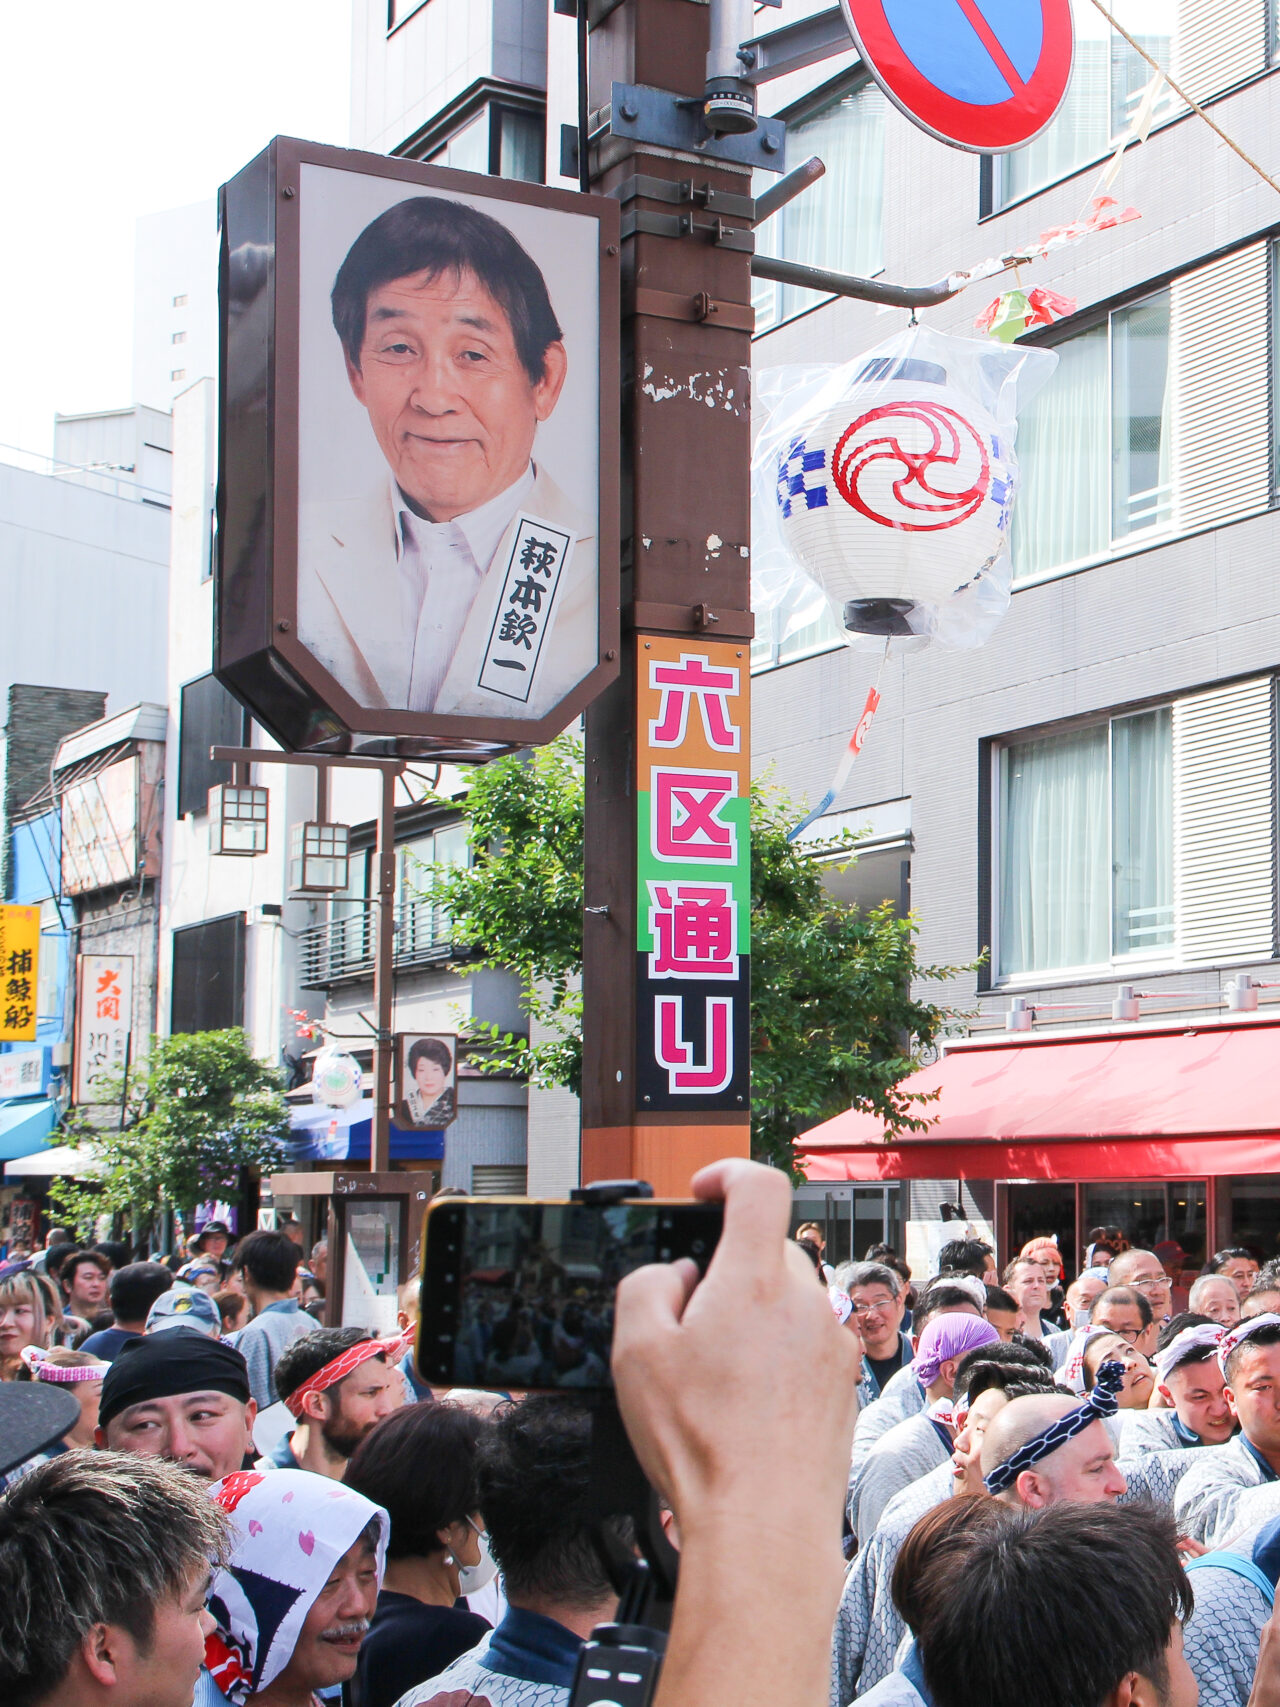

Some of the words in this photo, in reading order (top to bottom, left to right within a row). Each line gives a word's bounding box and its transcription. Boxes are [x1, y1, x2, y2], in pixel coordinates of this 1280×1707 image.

[493, 536, 558, 672] 萩本欽一
[648, 652, 741, 1095] 六区通り
[4, 948, 33, 1029] 捕鯨船
